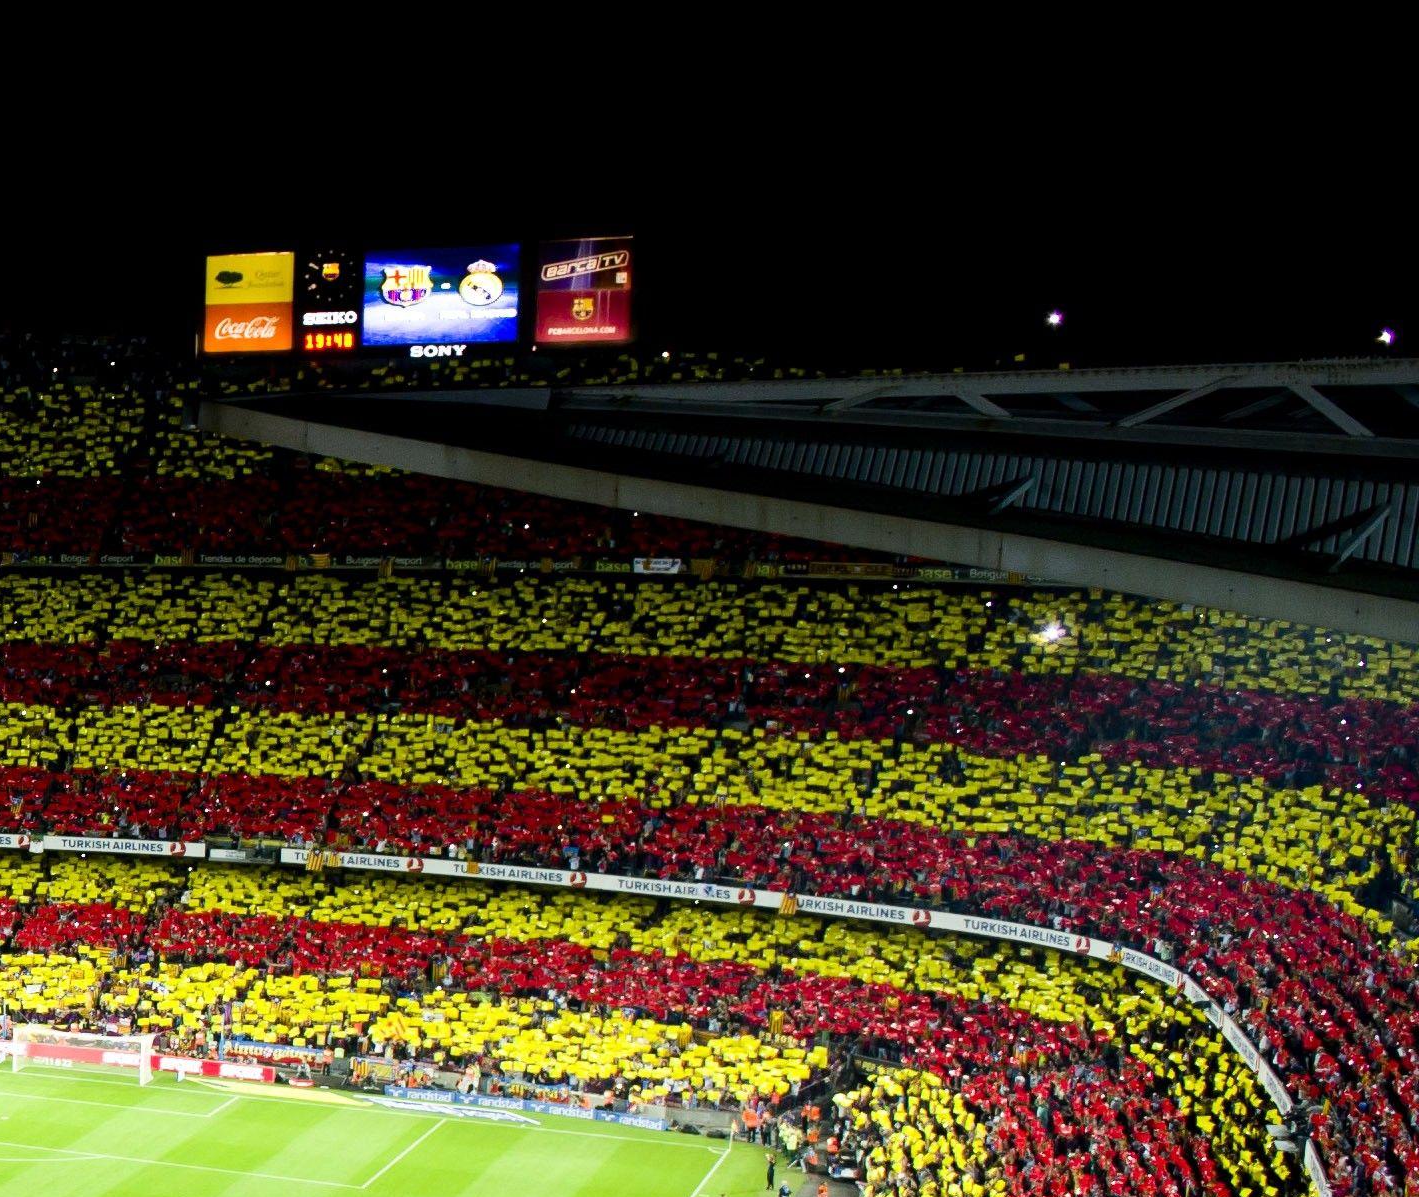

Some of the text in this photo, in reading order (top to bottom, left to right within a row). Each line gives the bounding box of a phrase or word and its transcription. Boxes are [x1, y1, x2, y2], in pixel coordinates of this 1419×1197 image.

[303, 310, 358, 326] SEIKO
[410, 344, 467, 358] SONY
[62, 839, 164, 852] TURKISH AIRLINES
[346, 856, 401, 869] AIRLINES
[508, 868, 564, 882] AIRLINES
[617, 879, 672, 895] TURKISH
[847, 903, 906, 920] AIRLINES
[964, 918, 1071, 947] TURKISH AIRLINES
